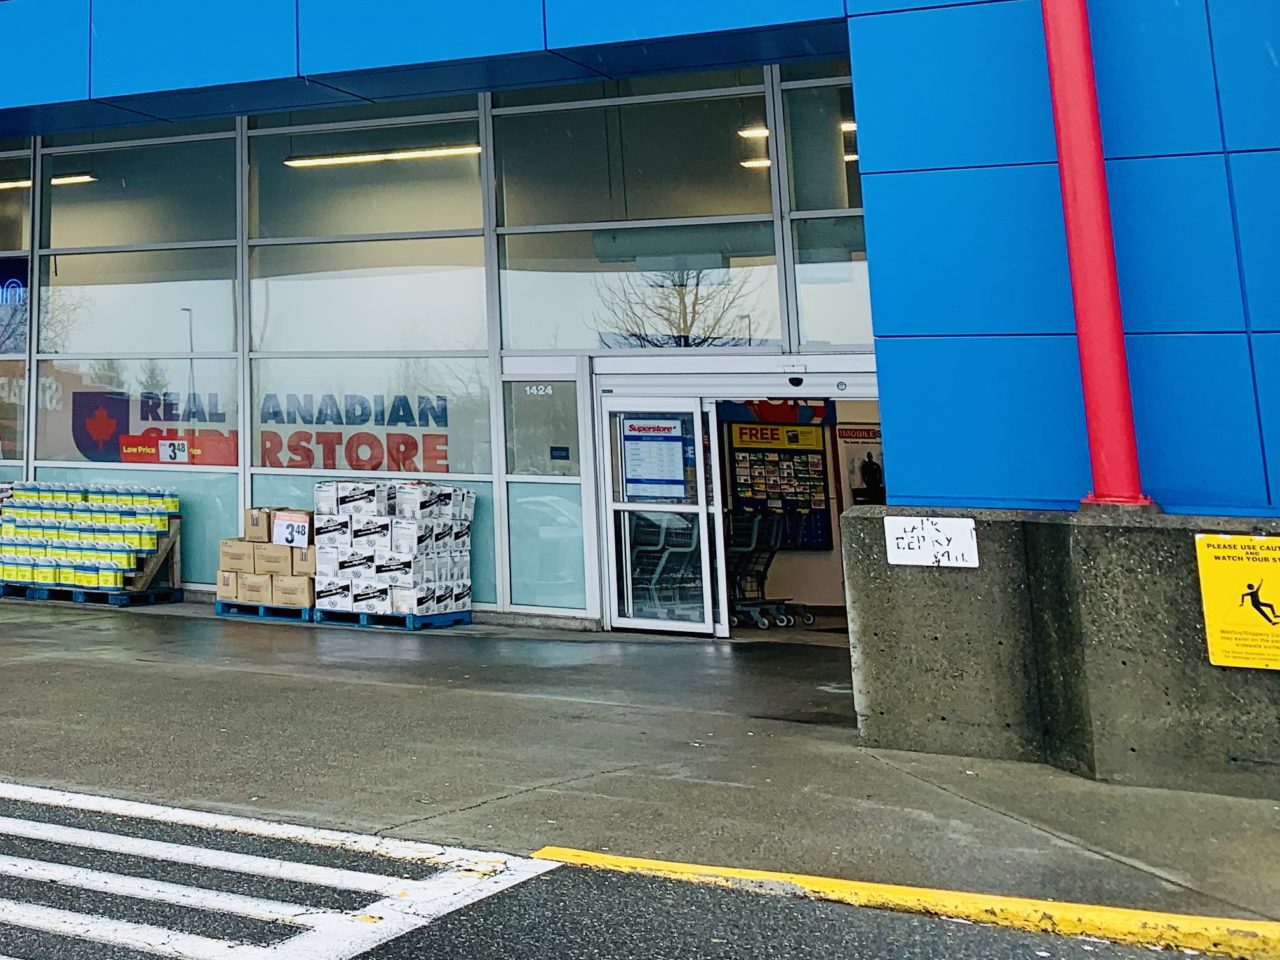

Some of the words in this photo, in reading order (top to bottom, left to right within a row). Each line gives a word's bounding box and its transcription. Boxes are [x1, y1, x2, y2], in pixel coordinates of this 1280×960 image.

[524, 385, 553, 395] 1424
[140, 392, 226, 423] REAL
[238, 394, 449, 427] ANADIAN
[628, 424, 673, 433] Superstore
[738, 426, 781, 441] FREE
[138, 446, 156, 454] Price
[139, 427, 449, 473] RSTORE
